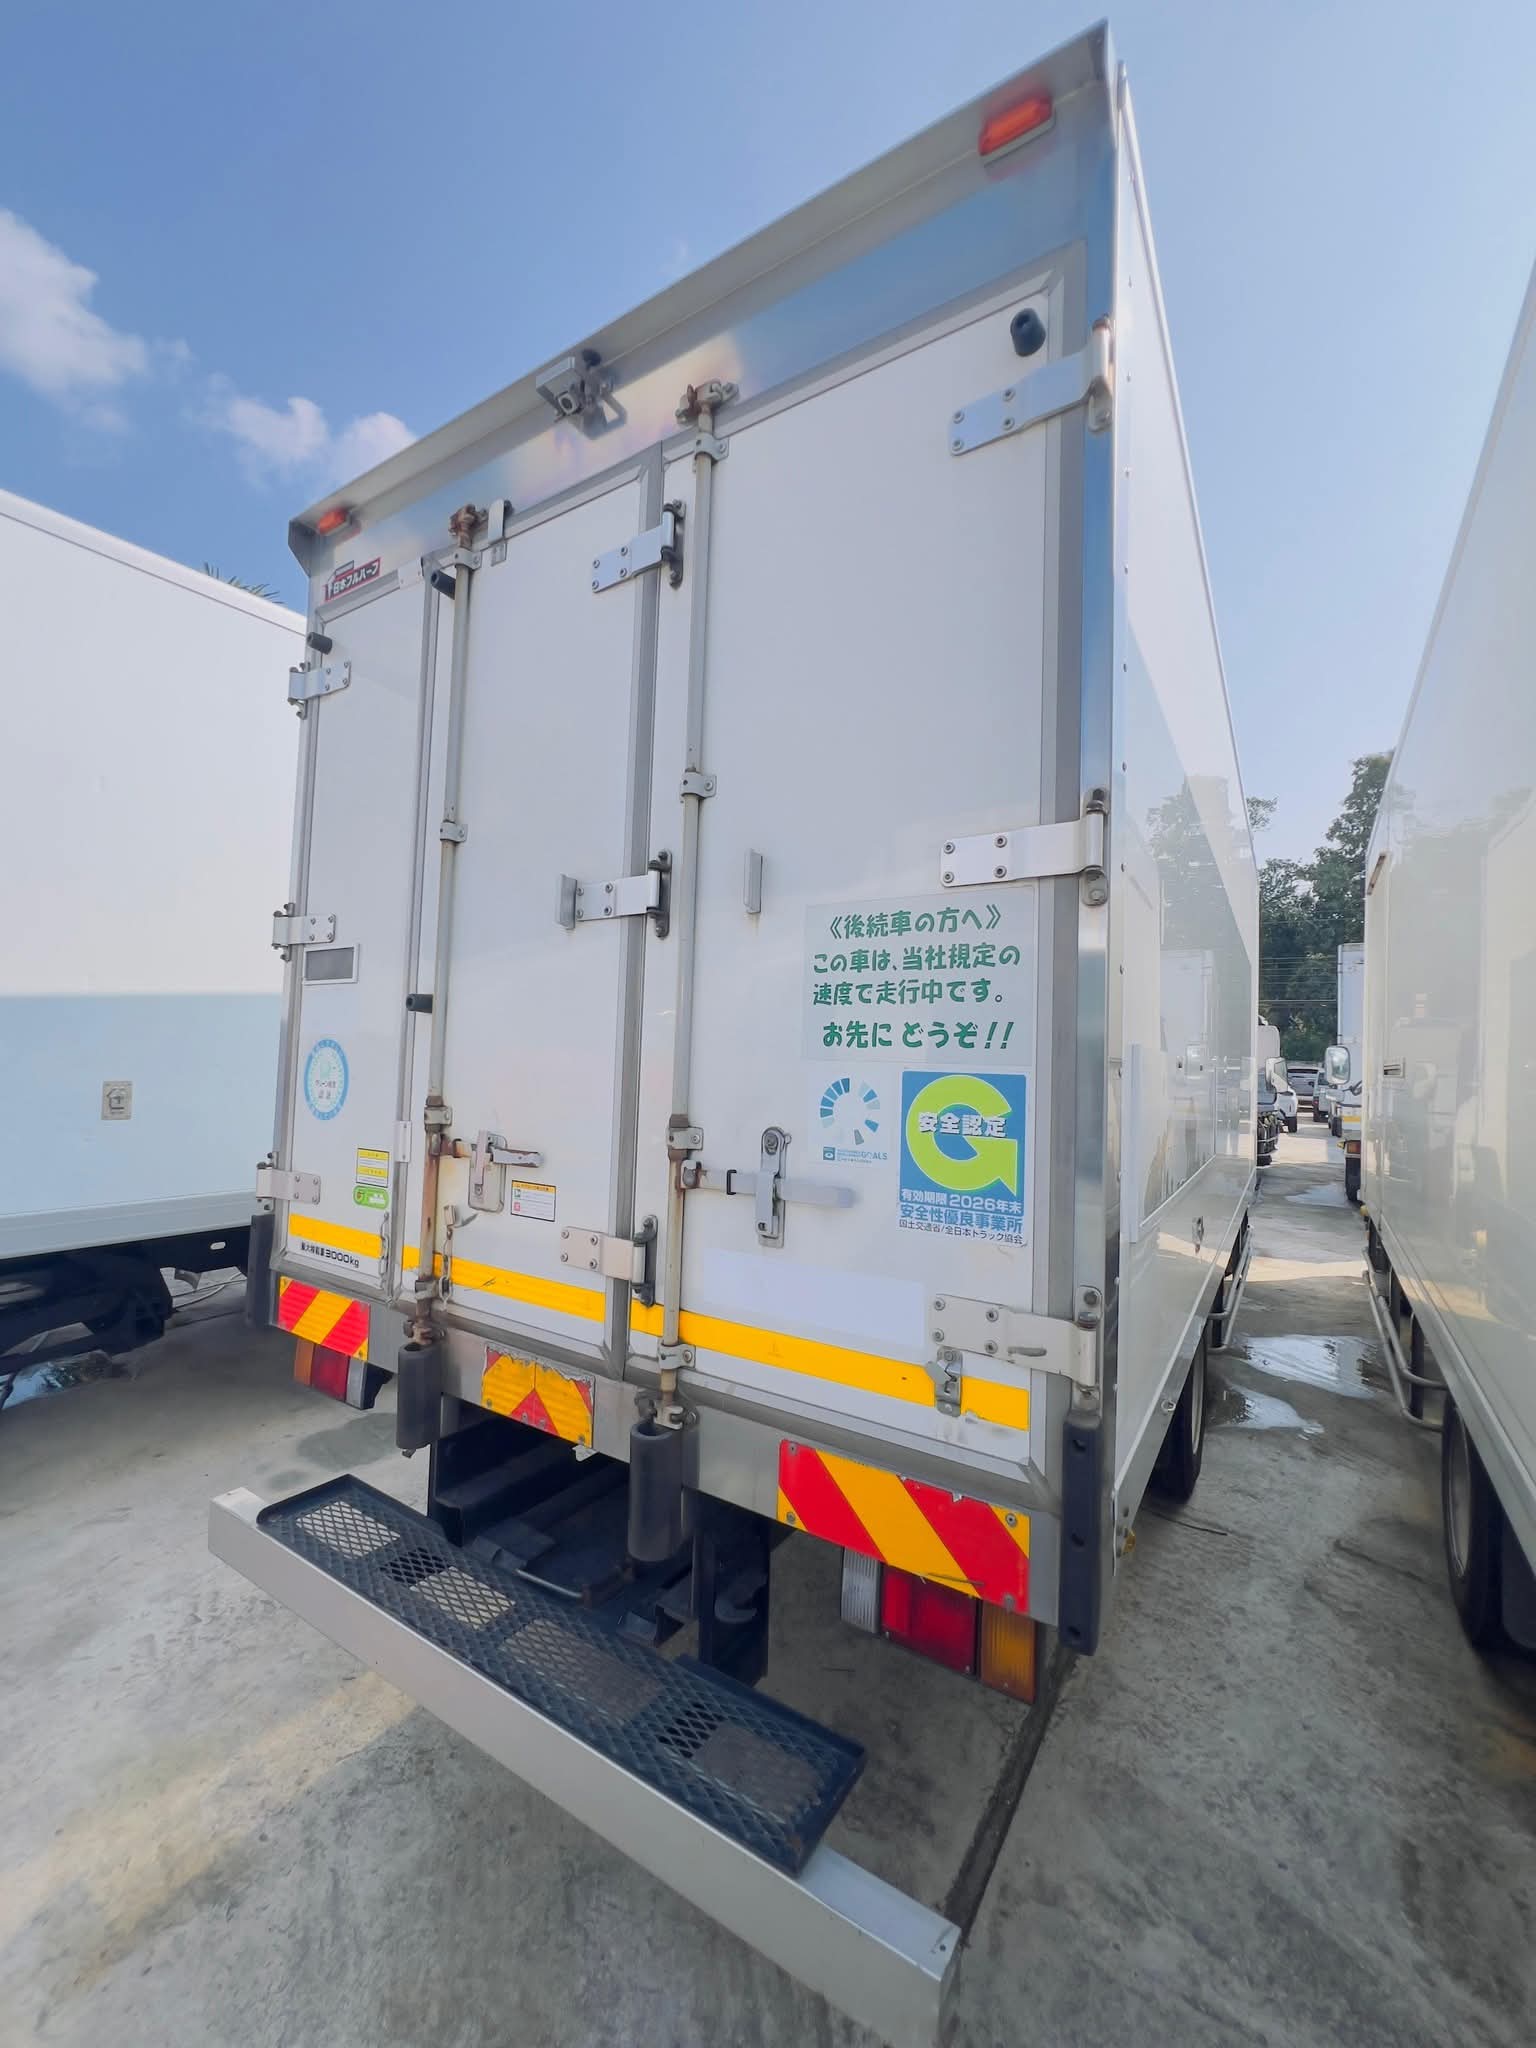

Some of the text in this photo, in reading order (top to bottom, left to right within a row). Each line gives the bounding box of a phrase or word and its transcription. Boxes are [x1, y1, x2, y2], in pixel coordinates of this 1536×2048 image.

[829, 903, 1001, 939] 《後続車の方へ》
[813, 942, 1021, 974] この車は、当社規定の
[812, 978, 1003, 1006] 速度で走行中です。
[917, 1111, 1008, 1138] 安全認定
[900, 1203, 1023, 1234] 安全性優良事業所
